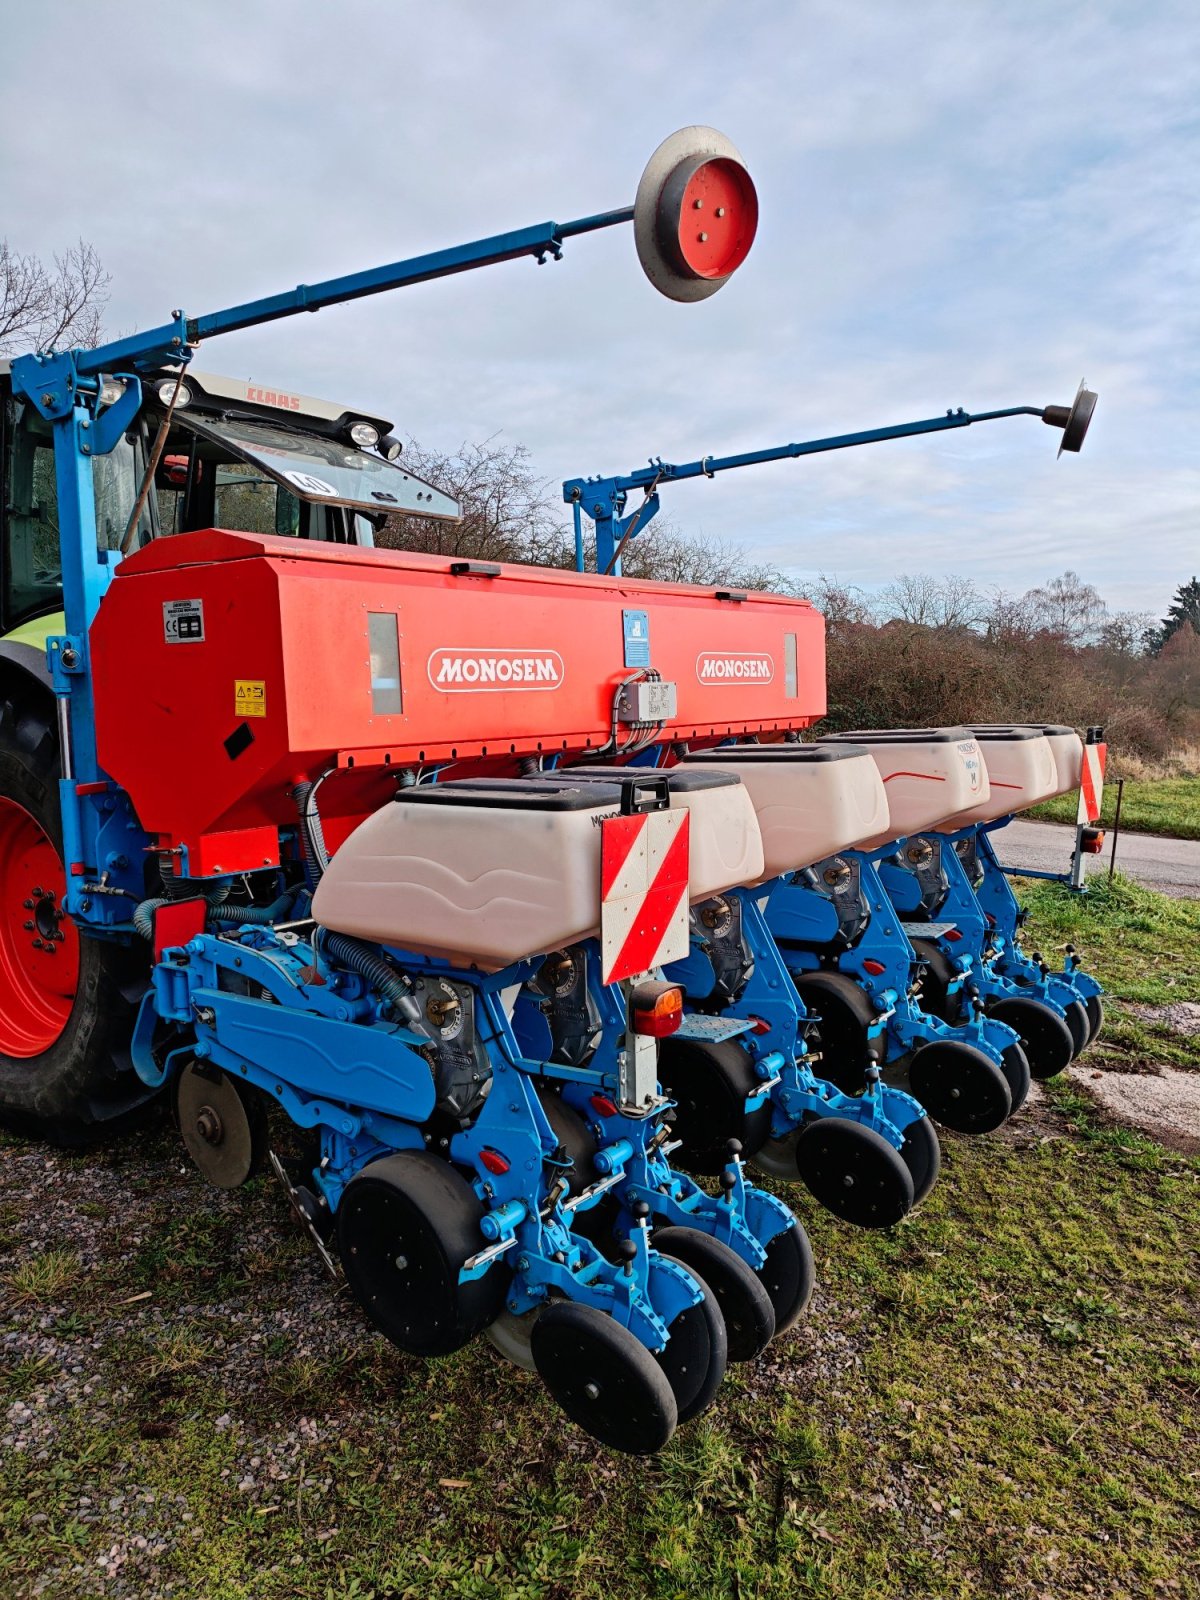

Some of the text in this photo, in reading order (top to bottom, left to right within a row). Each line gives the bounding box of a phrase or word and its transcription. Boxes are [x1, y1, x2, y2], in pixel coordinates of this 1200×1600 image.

[246, 387, 300, 410] CLAAS
[291, 474, 331, 493] 40
[437, 658, 558, 682] MONOSEM
[701, 659, 771, 677] MONOSEM
